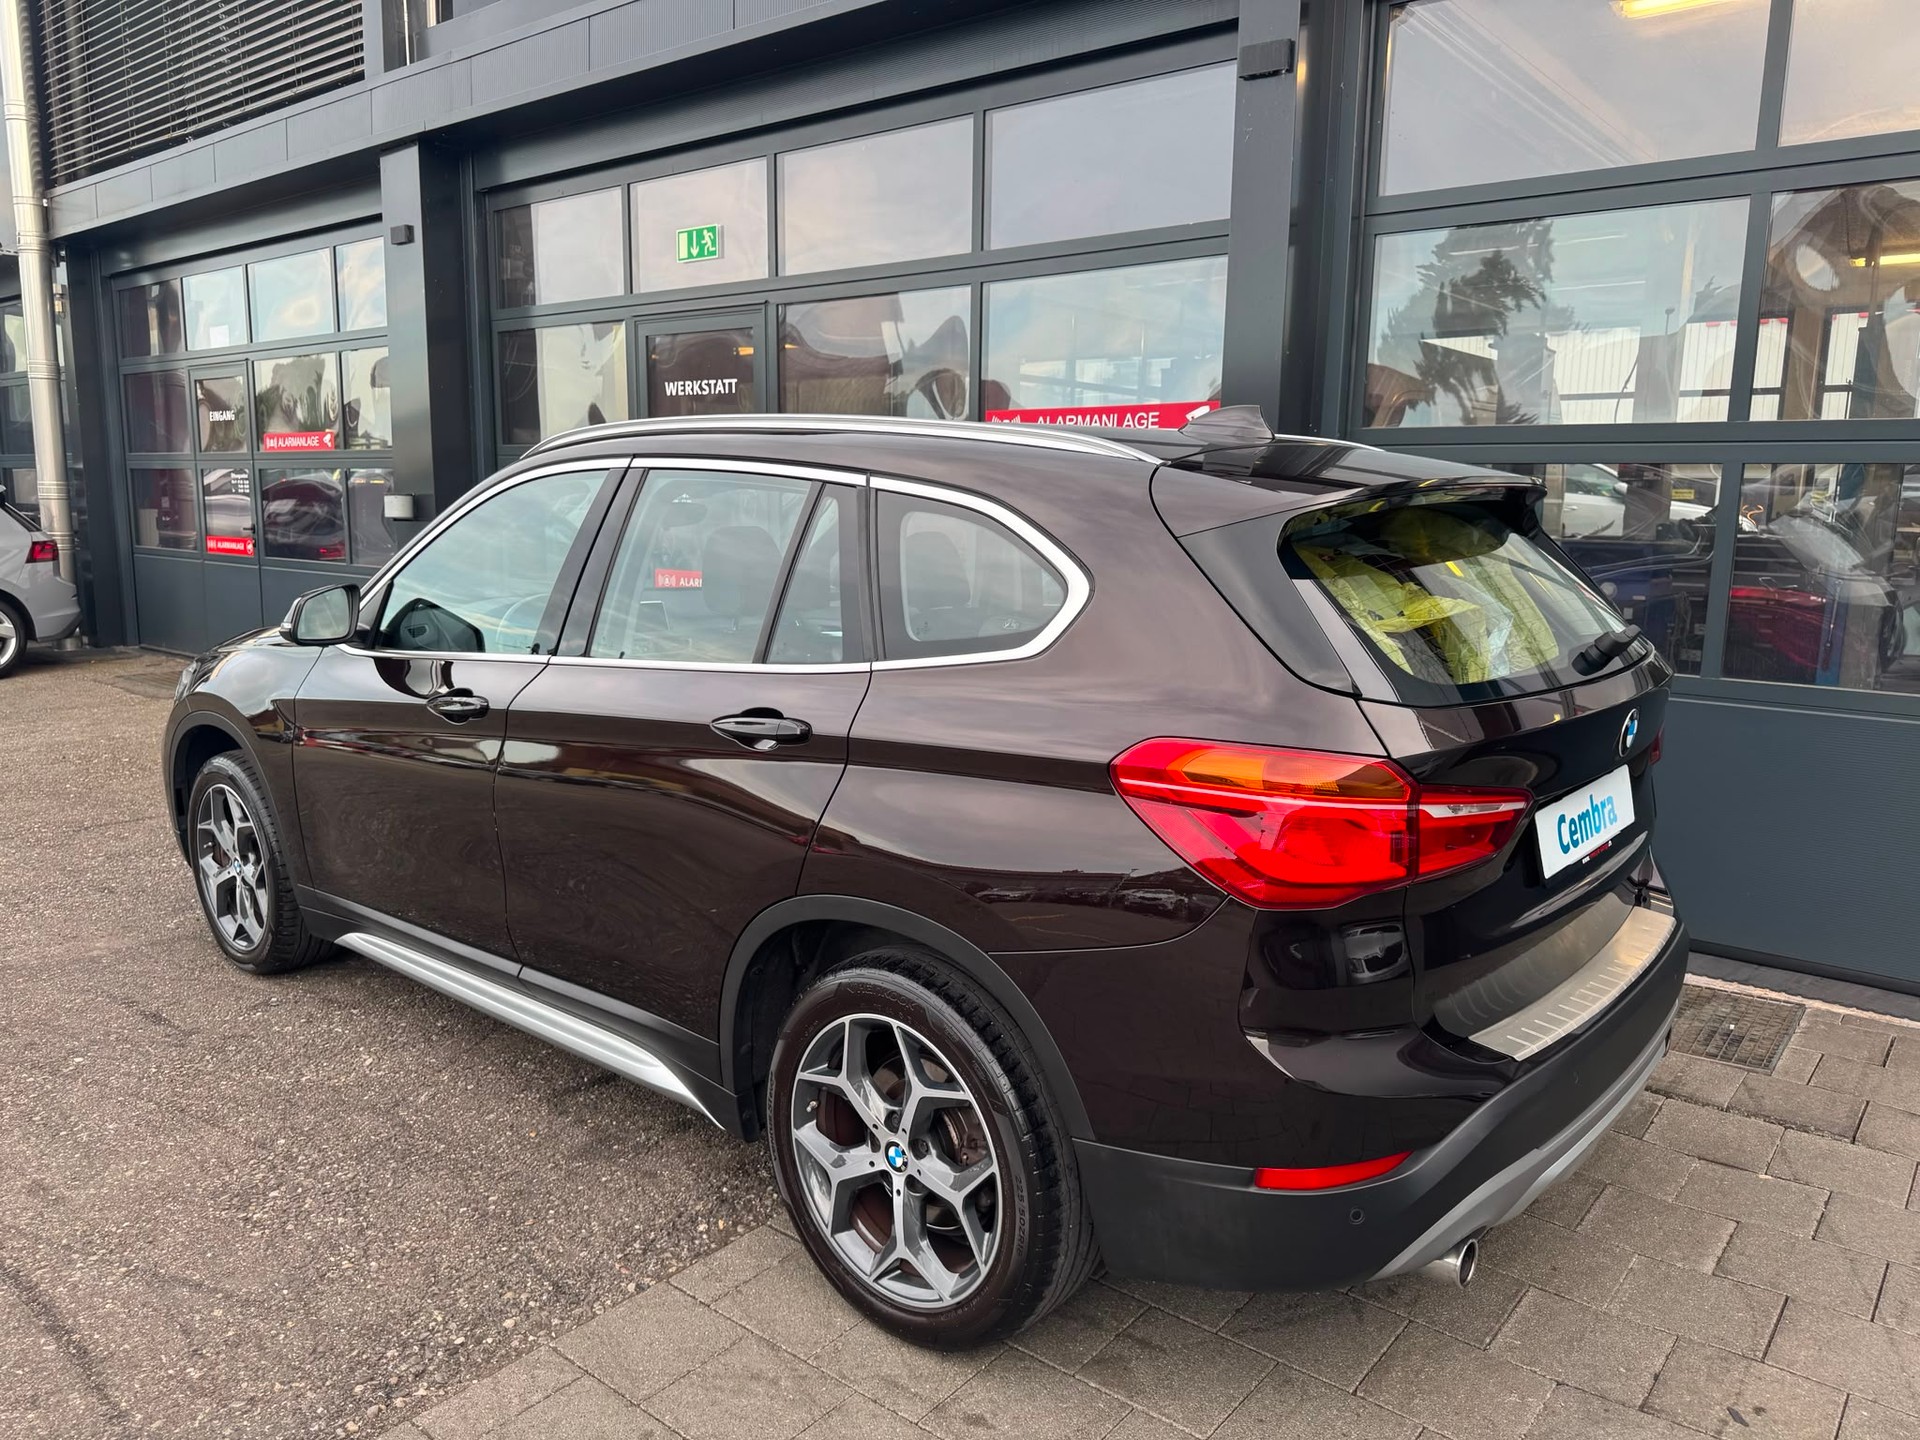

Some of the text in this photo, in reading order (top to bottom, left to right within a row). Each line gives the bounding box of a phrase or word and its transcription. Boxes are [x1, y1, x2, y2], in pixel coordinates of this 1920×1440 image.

[664, 378, 738, 397] WERKSTATT
[209, 410, 235, 422] EINGANG
[277, 435, 320, 448] ALARMANLAGE
[1557, 793, 1618, 855] Cembra
